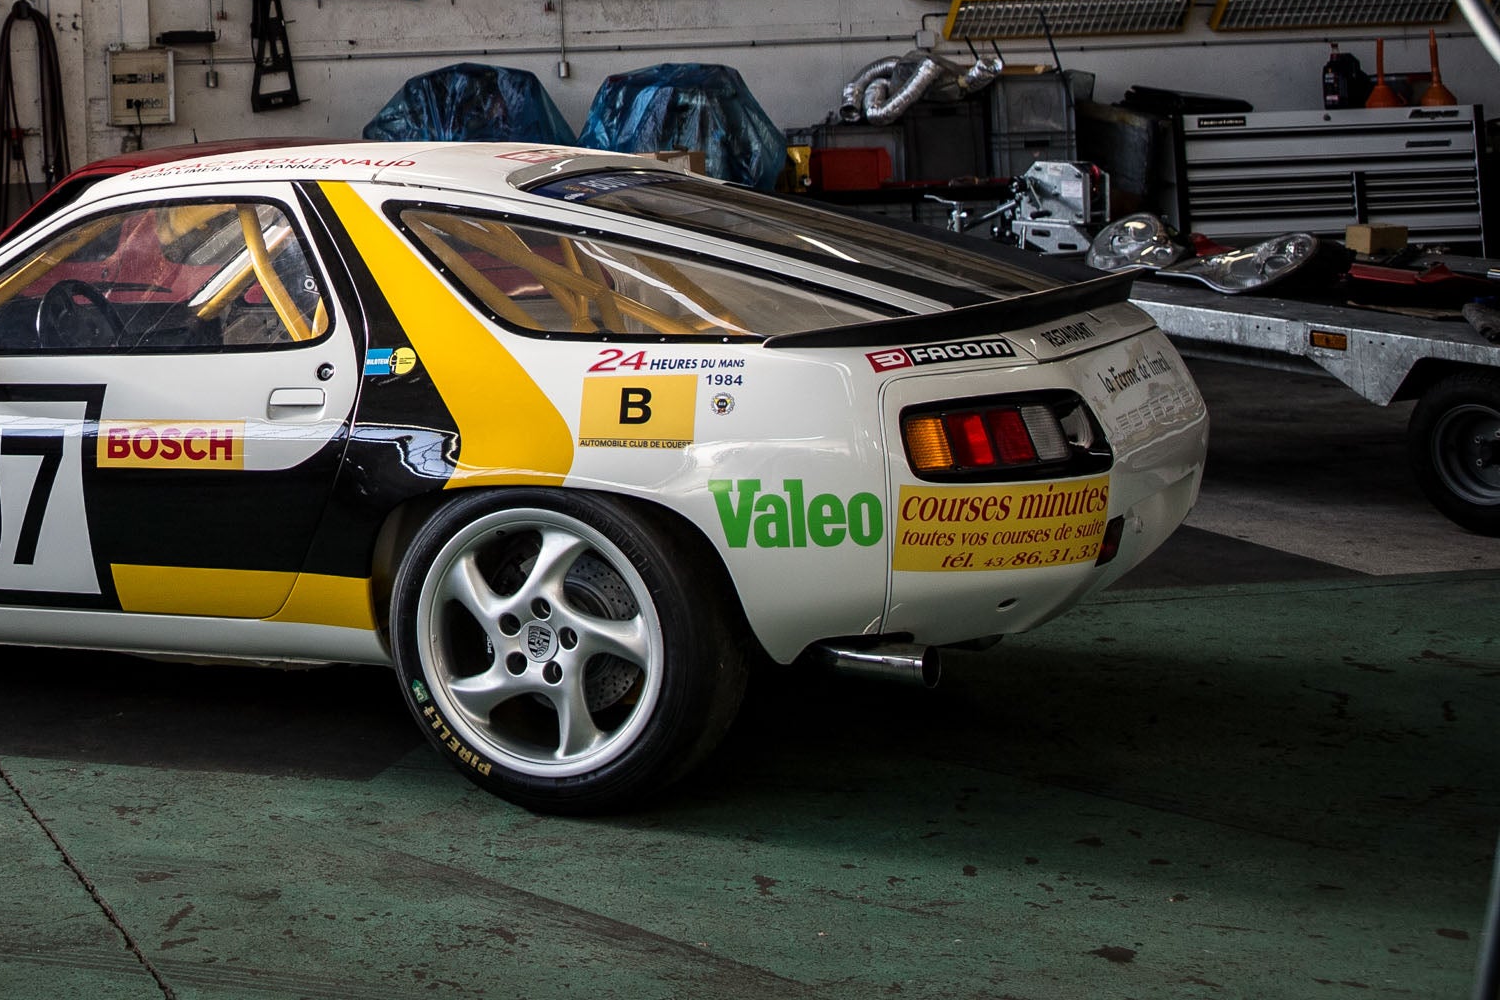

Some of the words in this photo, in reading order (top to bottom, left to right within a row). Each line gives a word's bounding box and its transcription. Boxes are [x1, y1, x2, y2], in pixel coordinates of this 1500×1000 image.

[248, 157, 416, 167] BOUTINAUD
[1041, 322, 1095, 347] RESTAURANT
[586, 348, 648, 373] 24
[650, 358, 698, 371] HEURES
[701, 359, 716, 369] DU
[718, 358, 745, 368] MANS
[911, 341, 1011, 362] FACOM
[704, 373, 743, 386] 1984
[619, 387, 653, 425] B
[108, 428, 233, 460] BOSCH
[579, 439, 627, 448] AUTOMOBILE
[629, 439, 648, 448] CLUB
[650, 439, 660, 448] DE
[662, 440, 692, 449] L'OUEST
[708, 479, 884, 548] Valeo
[901, 495, 1012, 522] courses
[1016, 484, 1109, 519] minutes
[901, 528, 956, 546] toutes
[961, 530, 989, 546] vos
[992, 527, 1051, 546] courses
[1054, 523, 1073, 541] de
[1075, 519, 1105, 538] suite
[941, 551, 975, 568] tél.
[422, 705, 492, 777] PIRELLI
